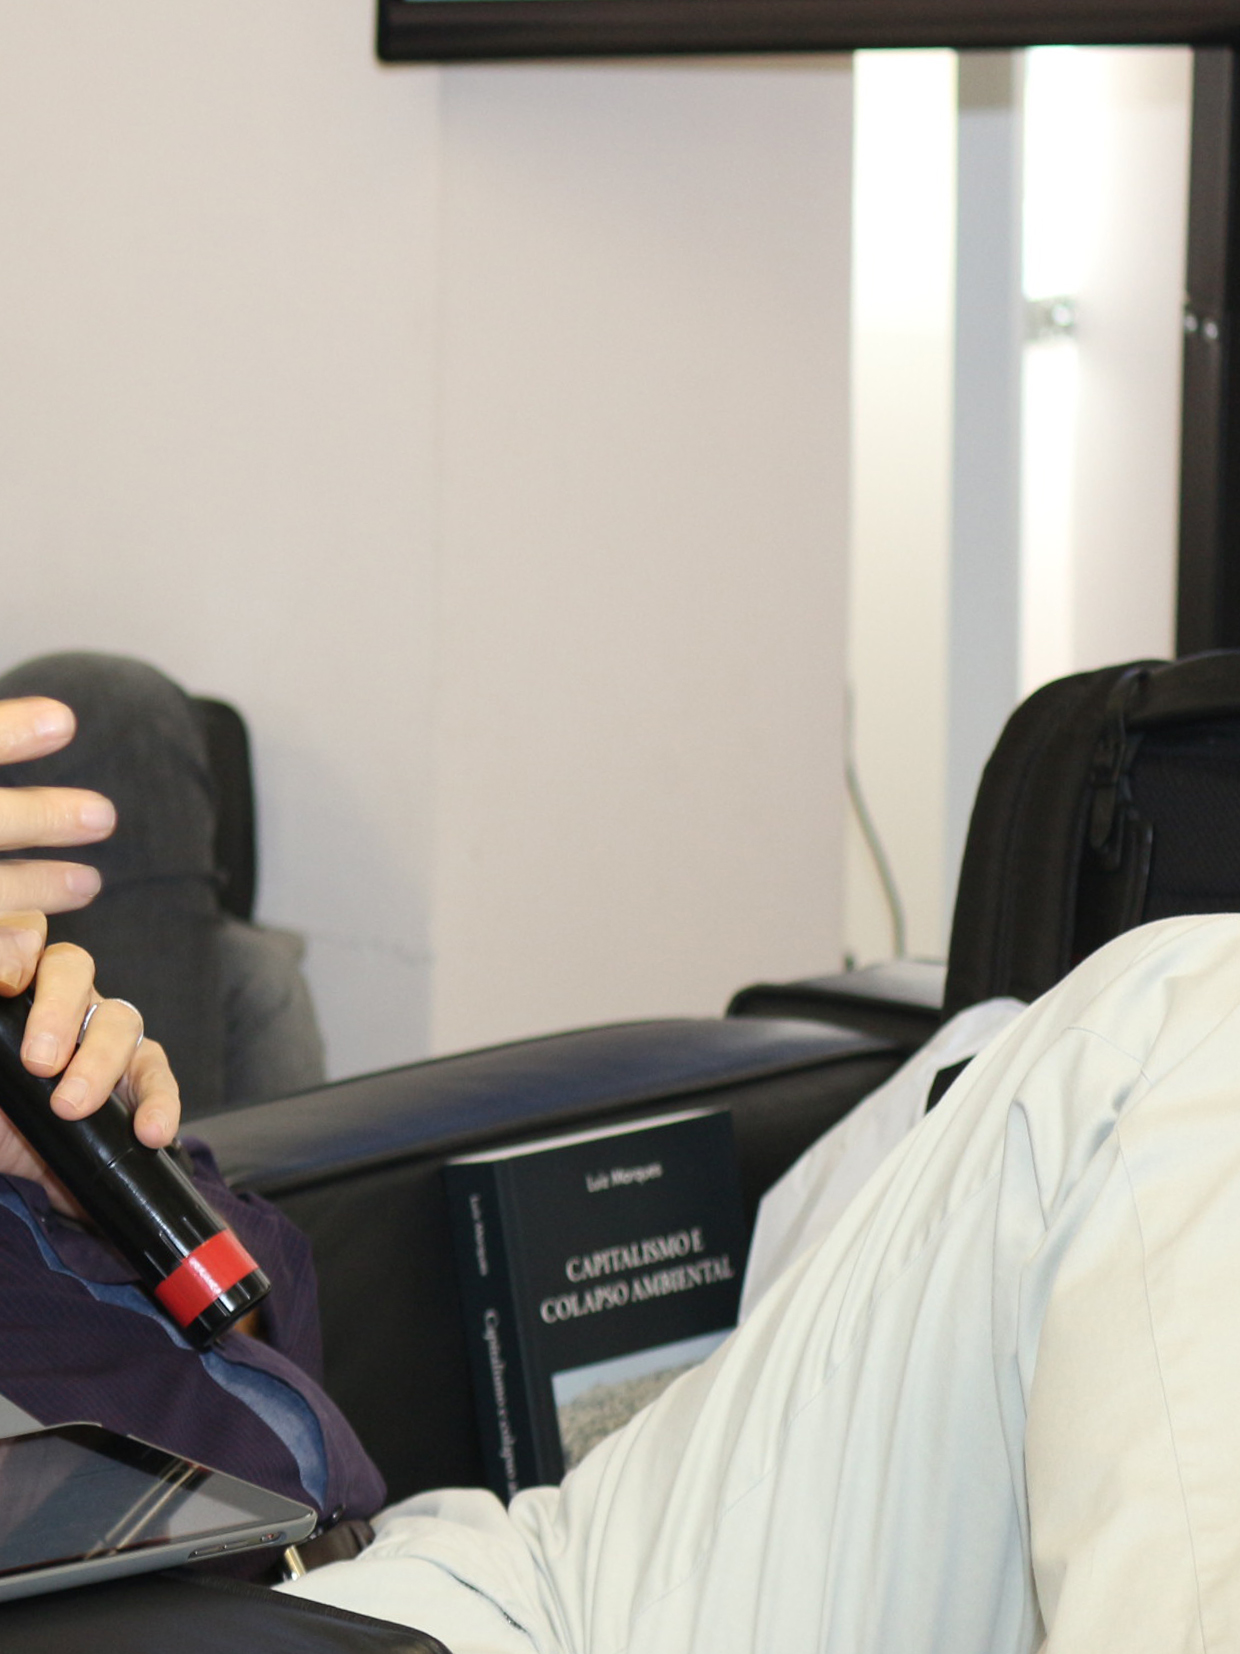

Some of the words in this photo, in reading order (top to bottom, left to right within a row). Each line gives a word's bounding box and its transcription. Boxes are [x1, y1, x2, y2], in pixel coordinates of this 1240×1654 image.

[611, 1162, 663, 1186] Marques
[565, 1230, 691, 1283] CAPITALISMO
[691, 1227, 705, 1253] E
[540, 1279, 630, 1324] COLAPSO
[631, 1253, 735, 1303] AMBIENTAL
